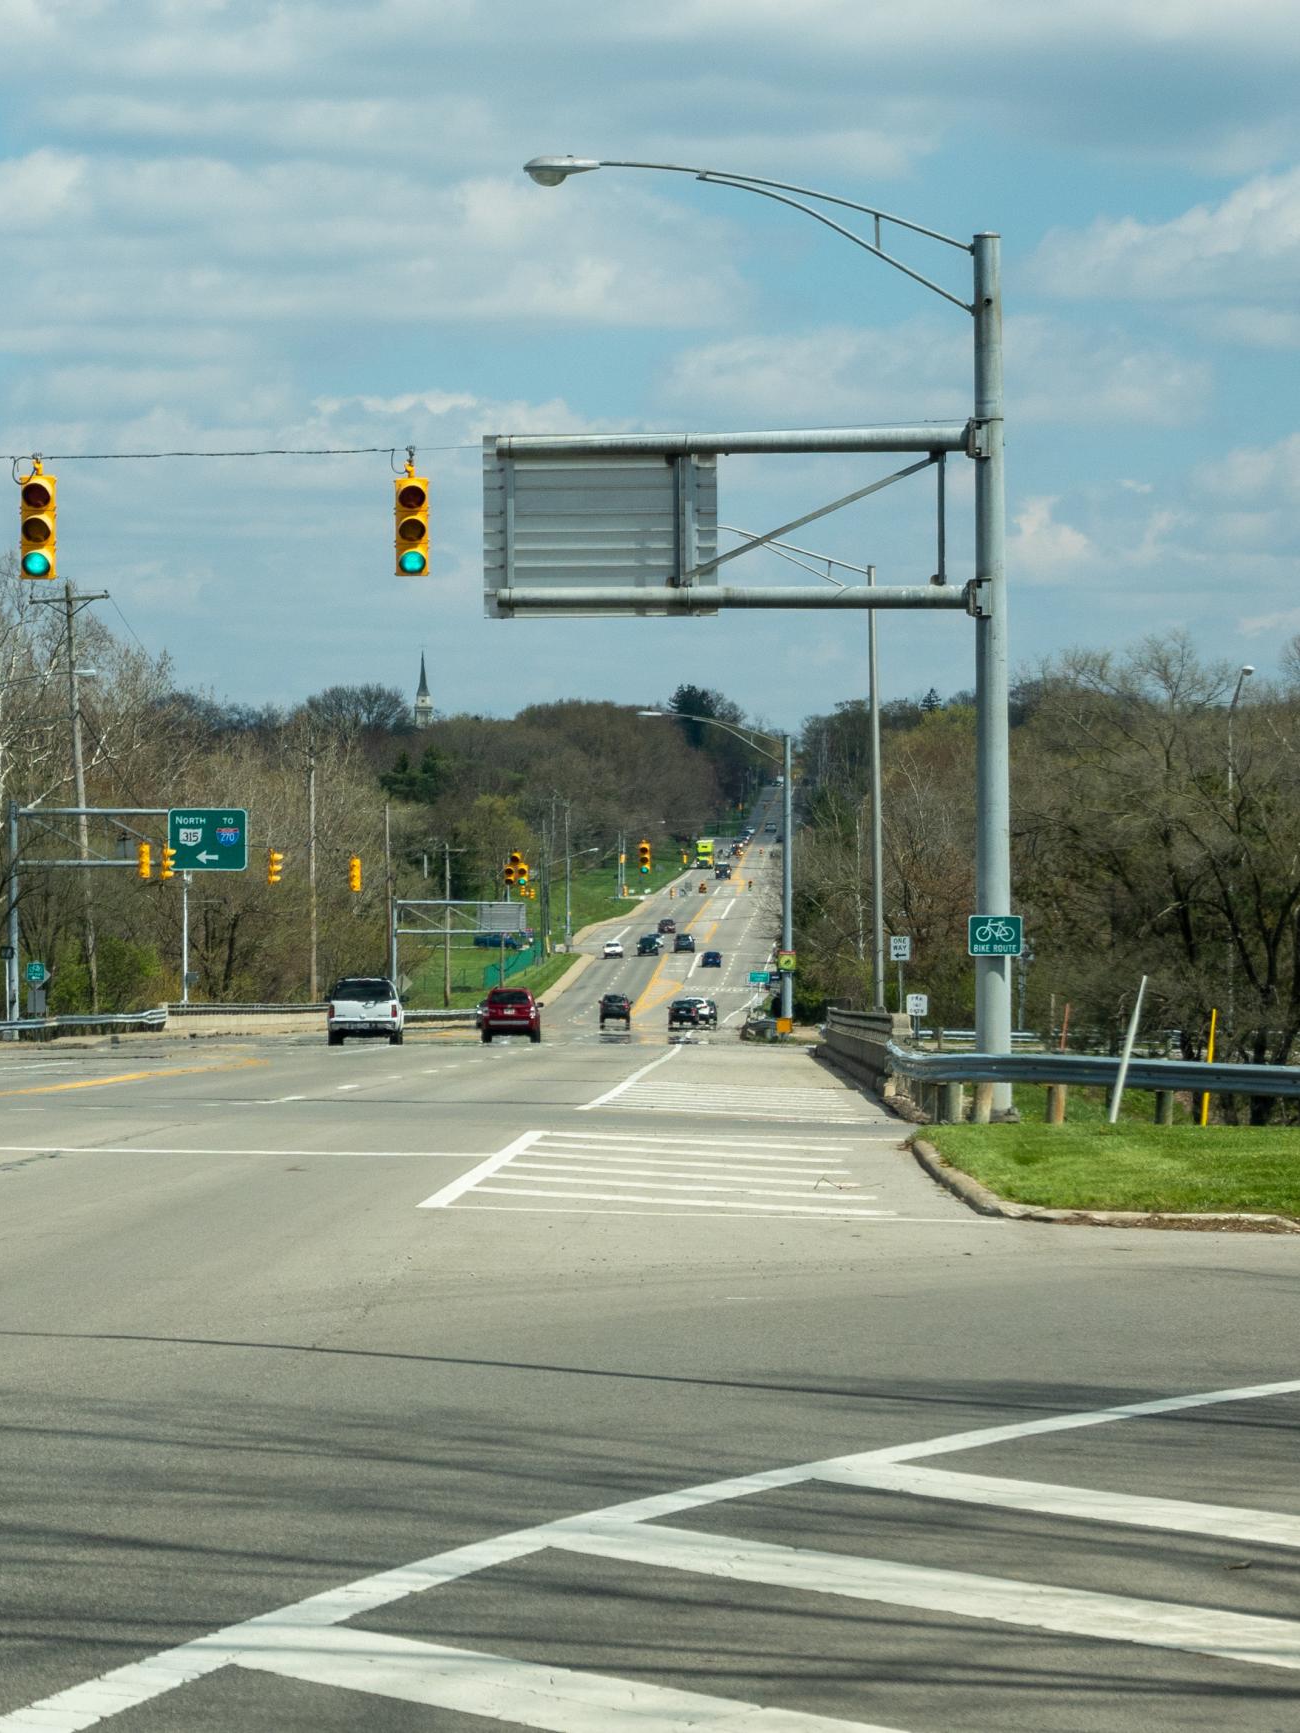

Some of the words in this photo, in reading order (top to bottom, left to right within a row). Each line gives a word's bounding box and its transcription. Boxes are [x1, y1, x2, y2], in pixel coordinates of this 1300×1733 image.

[175, 816, 206, 825] NORTH
[222, 817, 234, 825] TO
[182, 832, 199, 842] 315
[220, 833, 235, 842] 270
[893, 937, 907, 945] ONE
[973, 944, 991, 953] BIKE
[993, 944, 1017, 953] ROUTE
